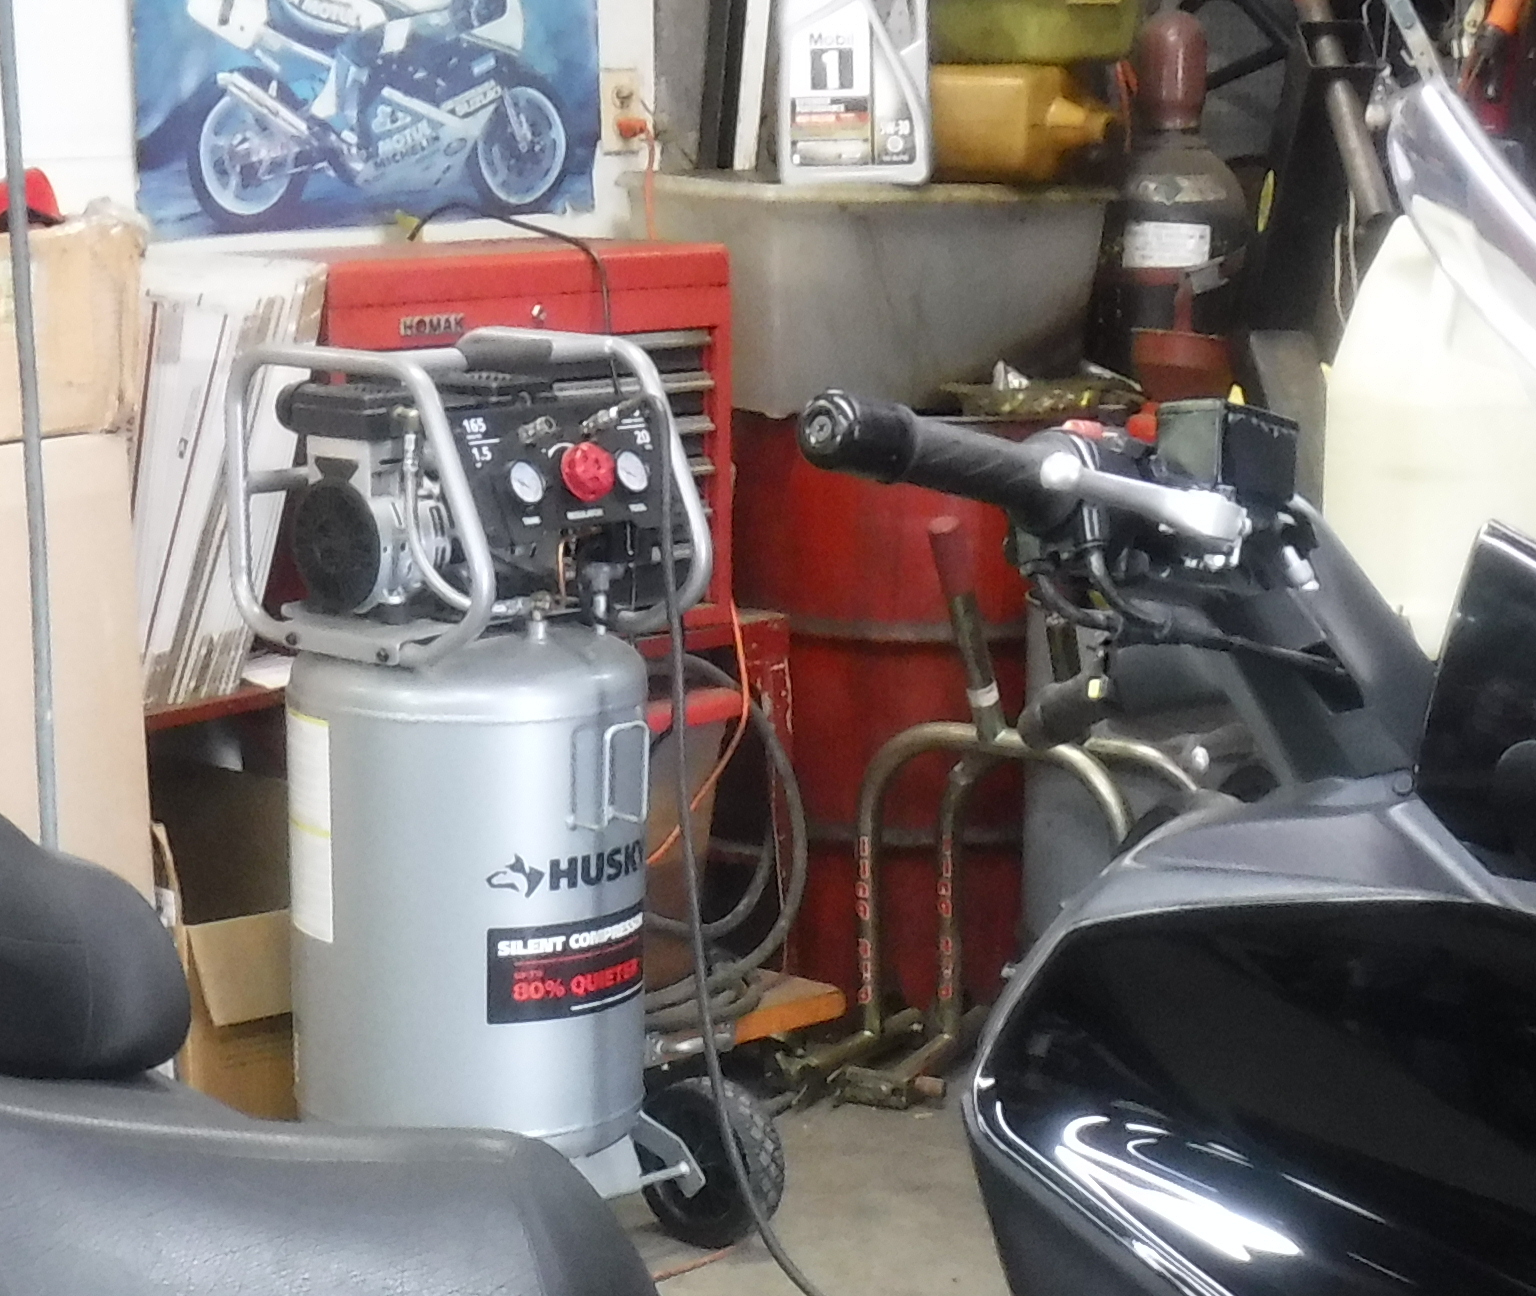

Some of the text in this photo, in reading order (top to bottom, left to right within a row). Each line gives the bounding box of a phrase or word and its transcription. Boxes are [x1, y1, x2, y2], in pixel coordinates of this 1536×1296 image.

[809, 33, 854, 46] Mobil
[399, 312, 465, 337] HOMAK
[462, 416, 487, 433] 165
[634, 429, 651, 445] 20
[471, 446, 492, 461] 1.5
[497, 935, 566, 957] SILENT
[513, 978, 565, 1002] 80%
